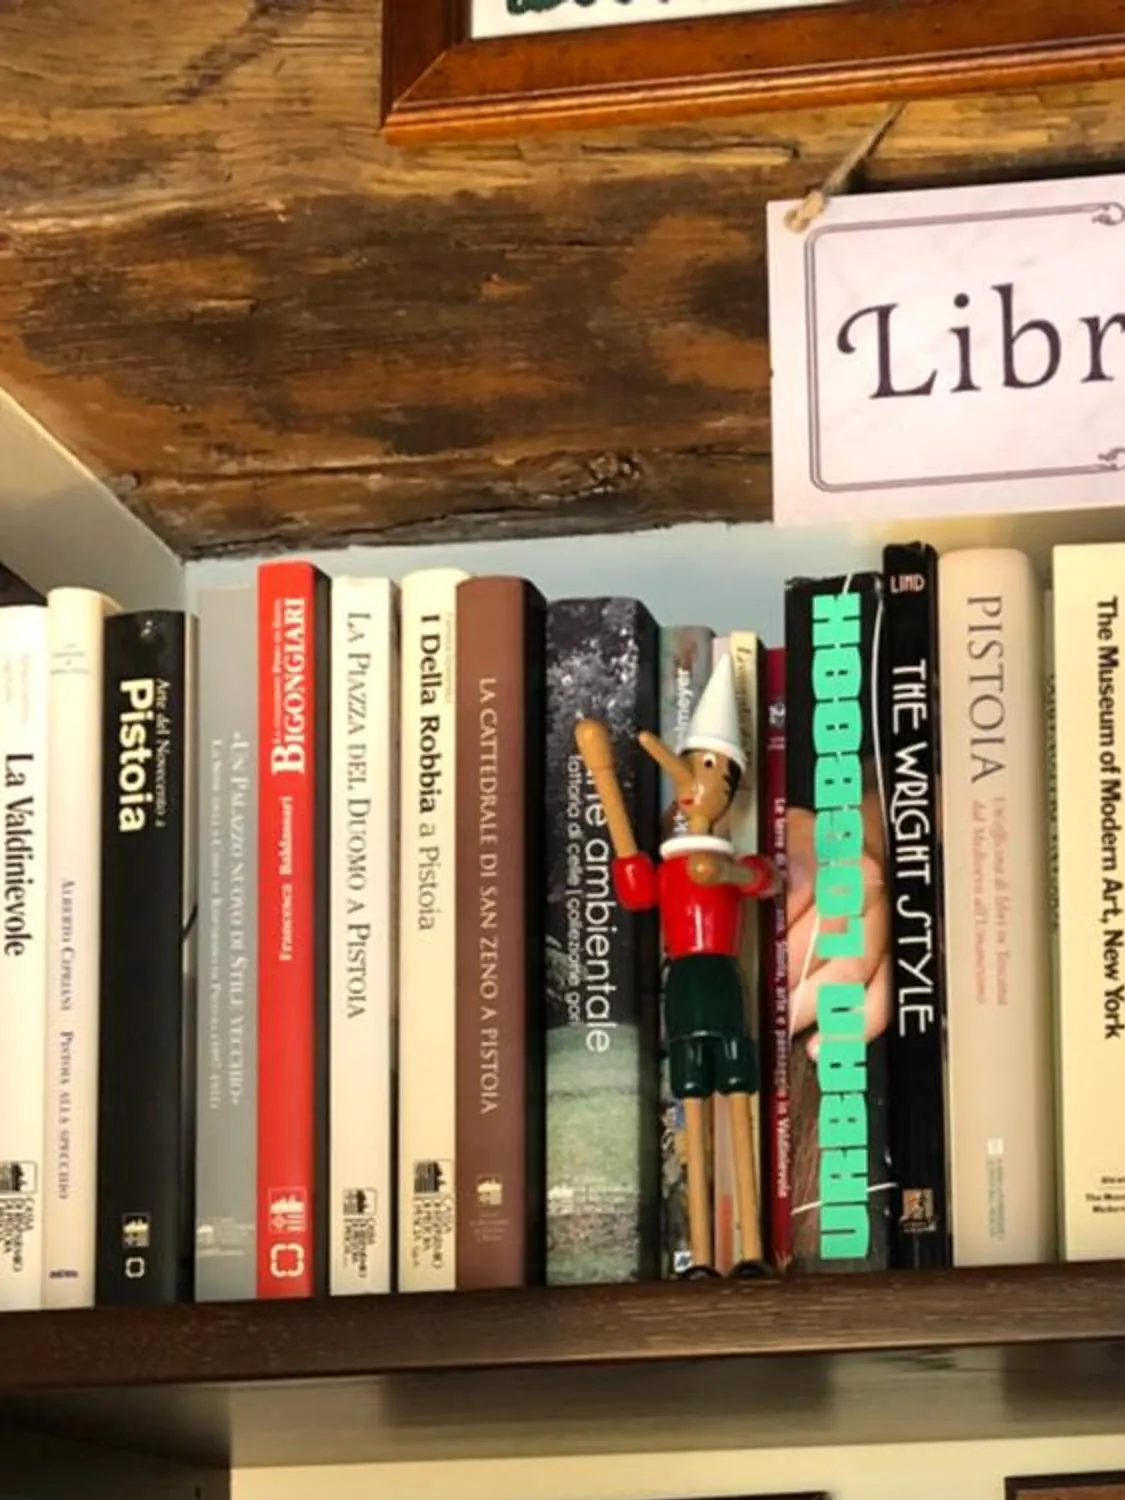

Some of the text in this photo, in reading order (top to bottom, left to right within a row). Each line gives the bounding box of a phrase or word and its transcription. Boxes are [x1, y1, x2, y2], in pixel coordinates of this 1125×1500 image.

[119, 679, 154, 833] Pistoia
[154, 740, 171, 817] Novecento
[155, 679, 171, 708] Arte
[155, 712, 172, 735] del
[271, 597, 306, 775] BIGONGIARI
[419, 614, 442, 931] I Della Robbia a Pistoia
[966, 594, 1006, 785] PISTOIA
[4, 753, 35, 957] La Valdinievole
[346, 611, 372, 1018] LA PIAZZA DEL DUOMO A PISTOIA
[479, 677, 499, 1114] LA CATTEDRALE DI SAN ZENO A PISTOIA
[890, 659, 934, 1037] THE WRIGHT STYLE
[1097, 596, 1125, 1040] The Museum of Modern Art, New York
[585, 838, 618, 1053] ambientale
[812, 592, 869, 1261] URBAN LOGBOOK
